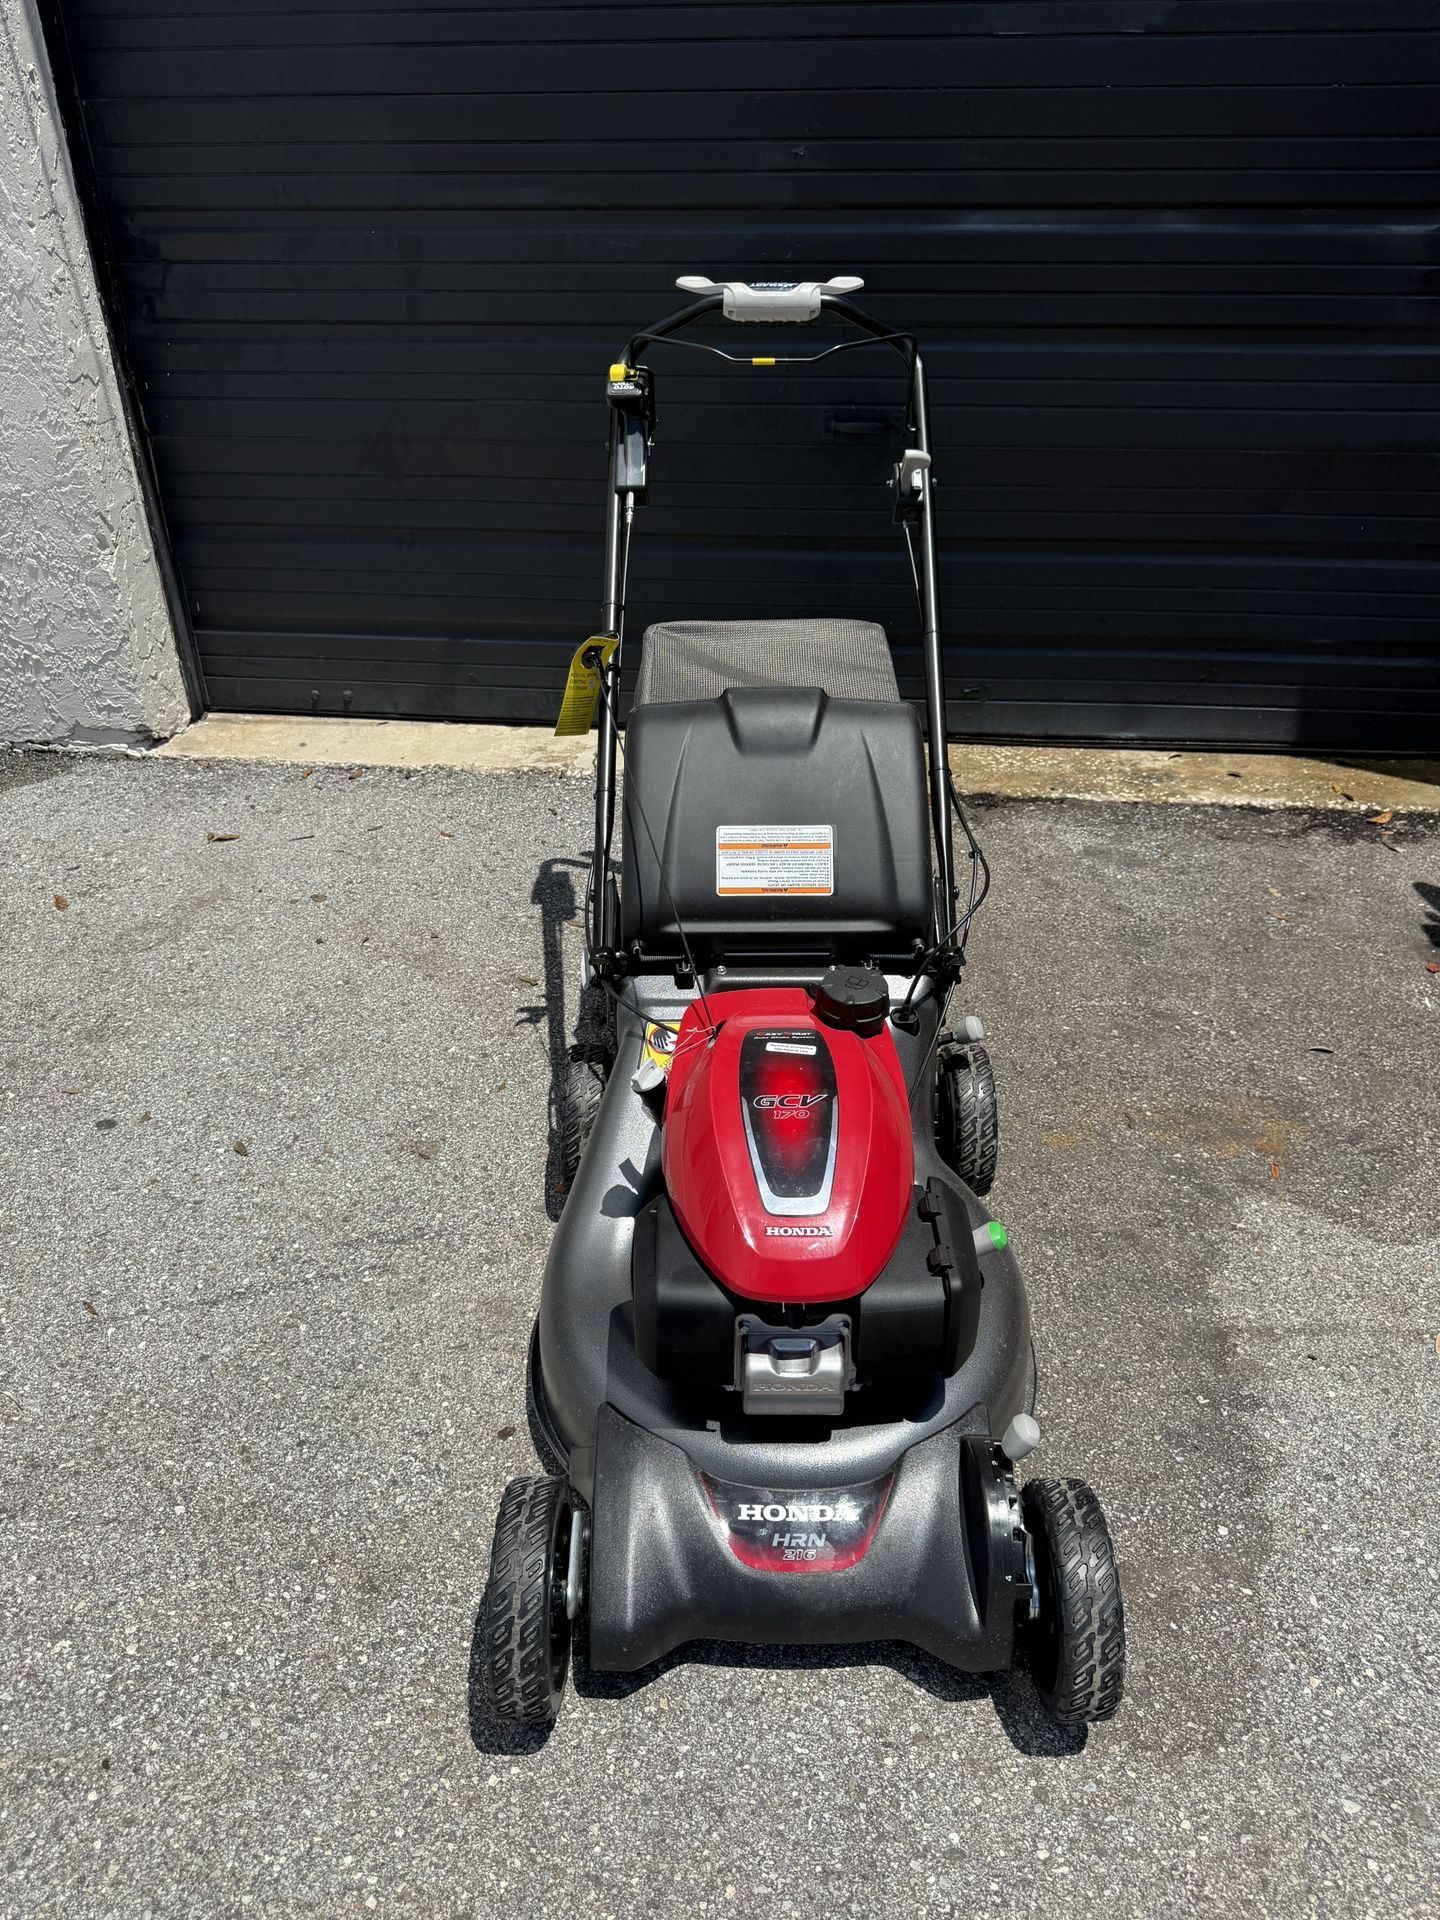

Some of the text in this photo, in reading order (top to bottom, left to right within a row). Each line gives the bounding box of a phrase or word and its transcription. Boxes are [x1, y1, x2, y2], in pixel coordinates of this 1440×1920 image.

[753, 1094, 828, 1109] GCV
[773, 1110, 810, 1119] 170
[765, 1227, 832, 1236] HONDA
[738, 1504, 859, 1522] HONDA
[772, 1533, 826, 1547] HRN
[782, 1549, 817, 1561] 216
